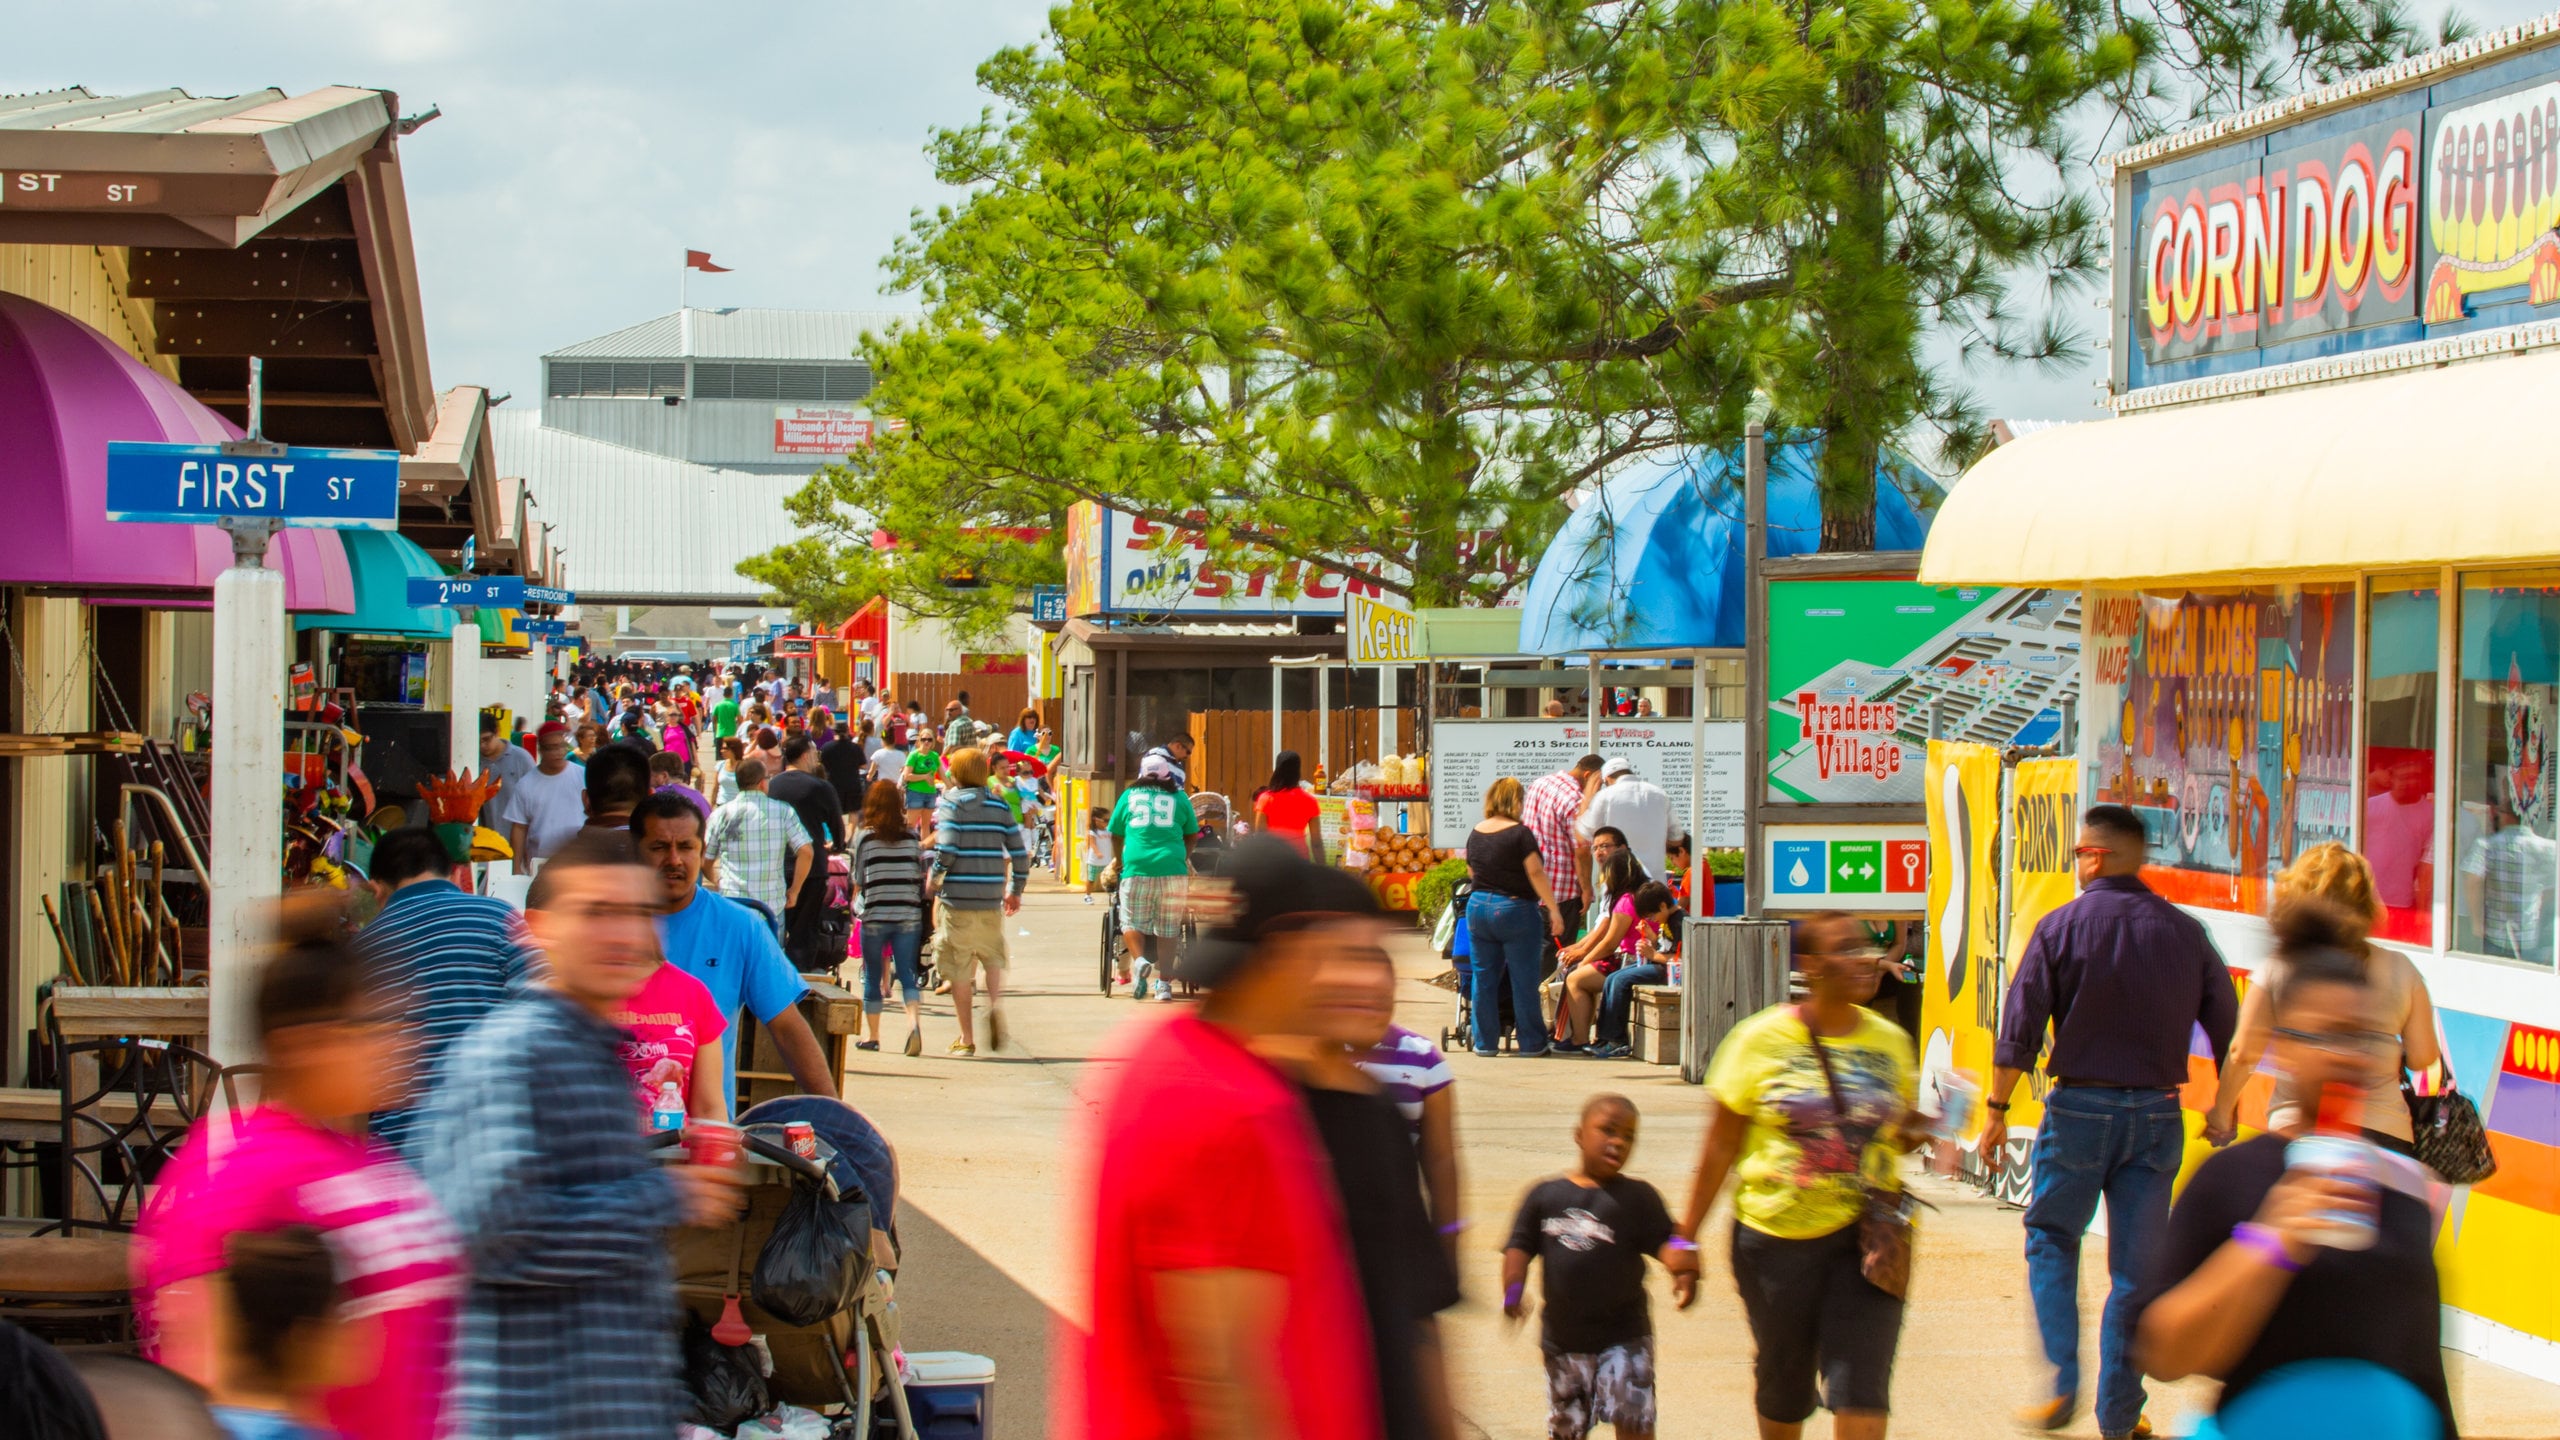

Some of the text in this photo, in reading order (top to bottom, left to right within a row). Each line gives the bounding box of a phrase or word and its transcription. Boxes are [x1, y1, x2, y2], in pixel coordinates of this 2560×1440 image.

[18, 173, 62, 192] ST
[107, 184, 137, 202] ST
[2147, 136, 2414, 338] CORN DOG
[783, 420, 867, 433] Thousands of Dealers
[783, 432, 815, 443] Millions
[817, 433, 827, 443] of
[178, 461, 356, 510] FIRST ST
[439, 582, 499, 603] 2ND ST
[527, 587, 568, 602] RESTROOMS
[1193, 560, 1382, 599] STICK
[1358, 597, 1415, 660] Kettl
[2091, 597, 2142, 638] MACHINE
[2147, 601, 2257, 678] CORN DOGS
[2095, 646, 2130, 686] MADE
[1797, 691, 1895, 739] Traders
[1514, 740, 1694, 749] 2013 SPECIA EVENTS CALAND
[1815, 733, 1900, 781] Village
[1128, 794, 1175, 828] 59
[2016, 793, 2057, 873] CORN
